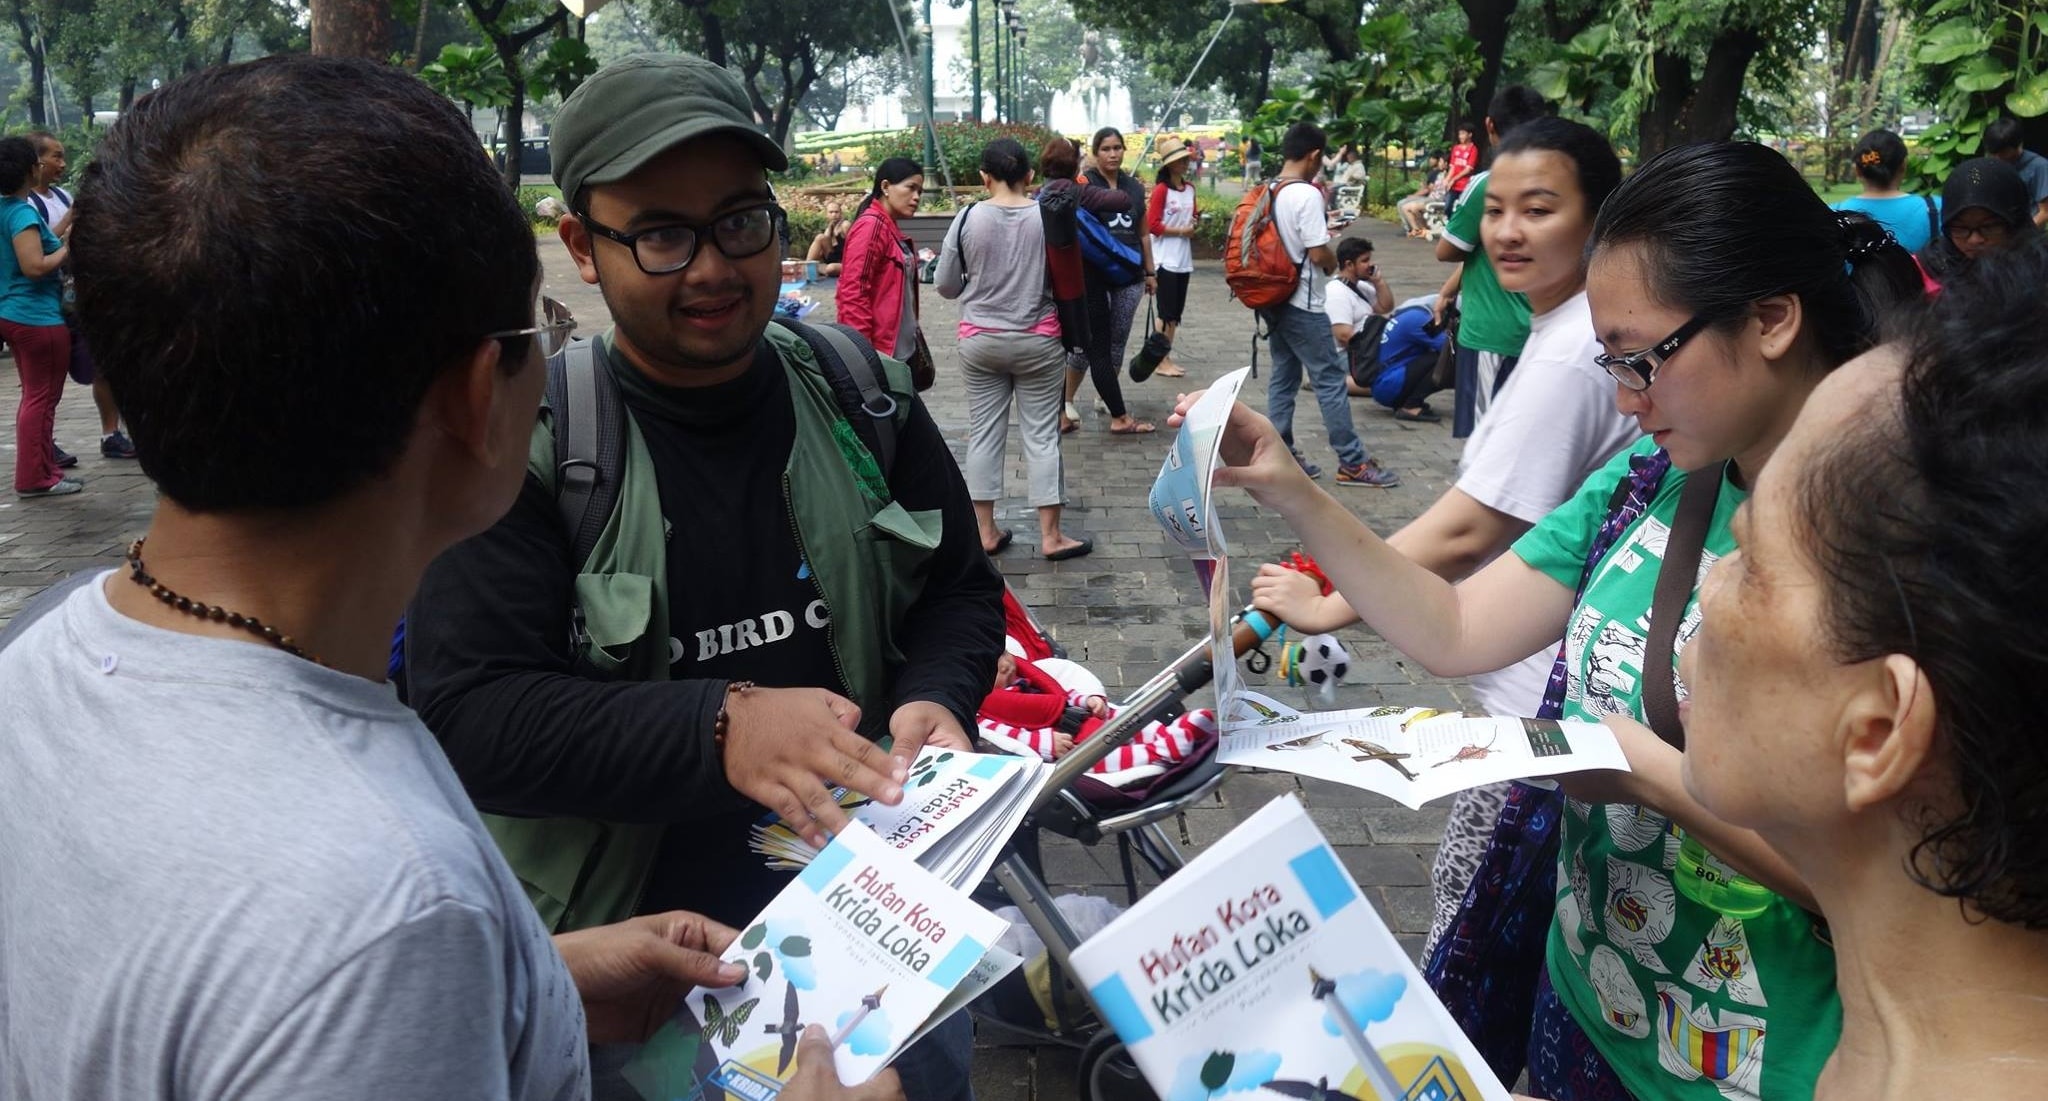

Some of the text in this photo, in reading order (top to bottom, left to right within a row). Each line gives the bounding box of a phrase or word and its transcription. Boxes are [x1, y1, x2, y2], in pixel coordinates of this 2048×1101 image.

[696, 610, 794, 661] BIRD
[895, 786, 979, 849] Hutan Kota
[921, 778, 969, 814] Krida
[825, 883, 930, 973] Krida Loka
[853, 865, 946, 944] Hutan Kota
[1139, 883, 1283, 985] Hutan Kota
[1152, 909, 1311, 1025] Krida Loka
